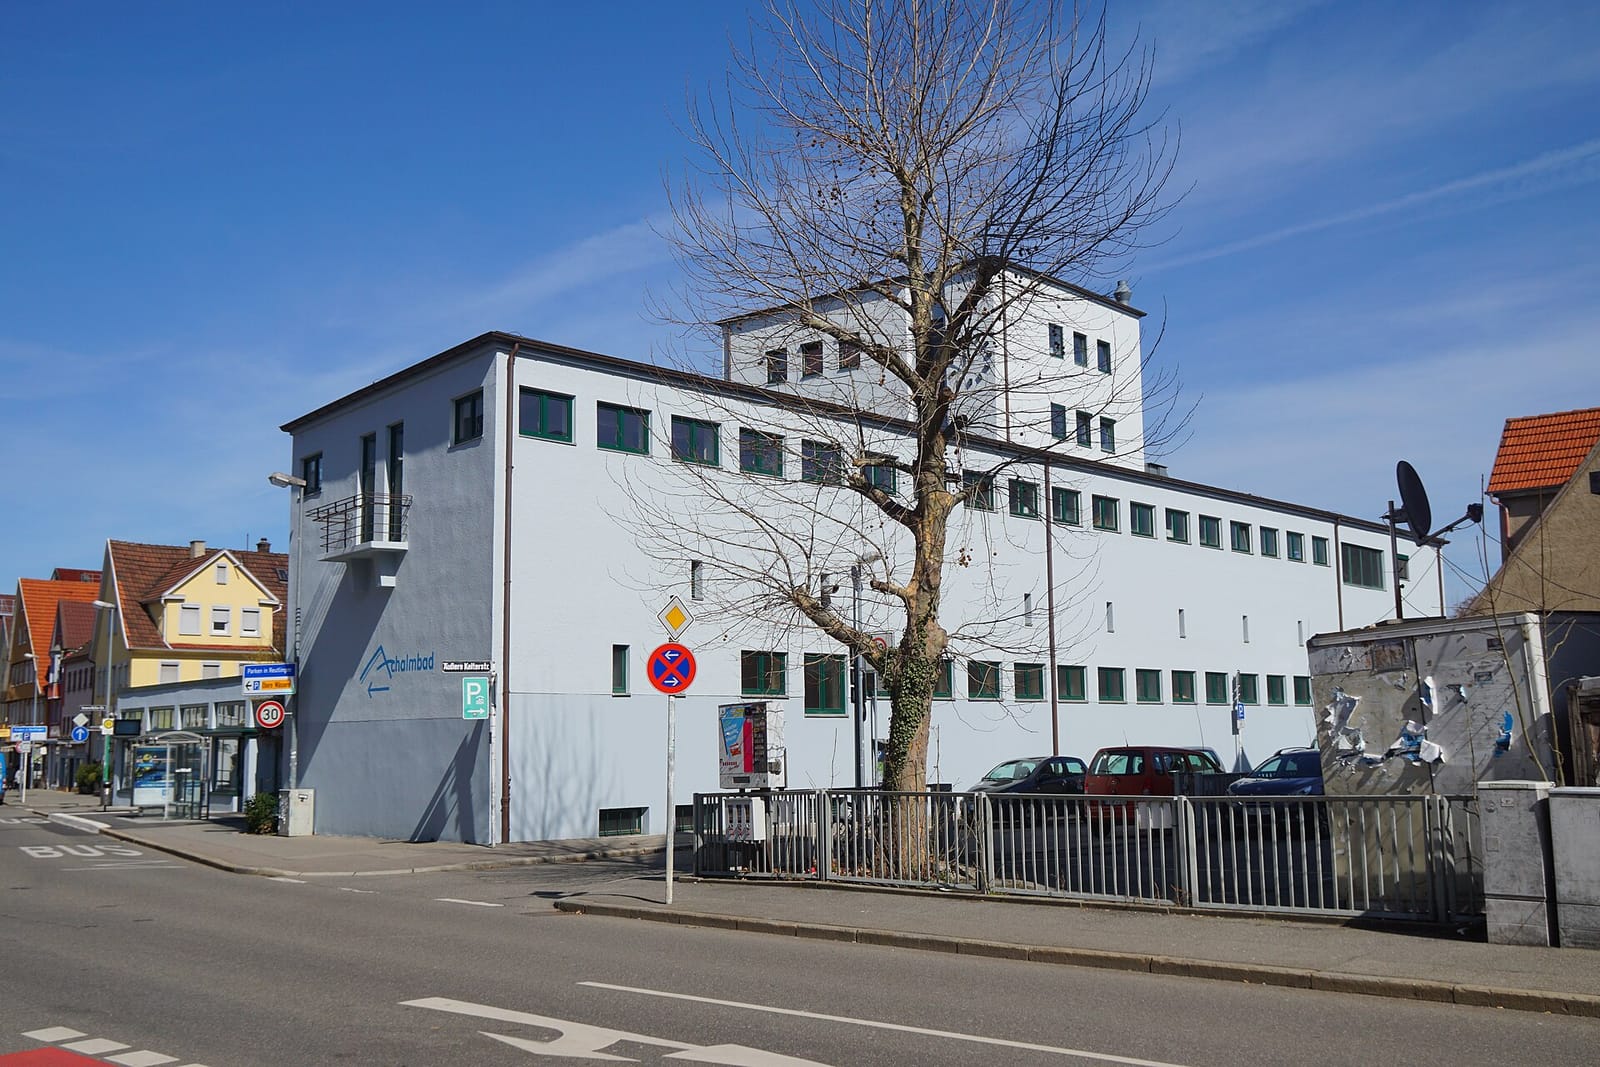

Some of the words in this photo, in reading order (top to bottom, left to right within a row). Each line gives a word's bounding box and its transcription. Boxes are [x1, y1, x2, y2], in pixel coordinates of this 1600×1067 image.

[360, 644, 435, 684] Achalmbad
[467, 682, 481, 705] P
[263, 709, 279, 720] 30
[19, 845, 143, 858] BUS
